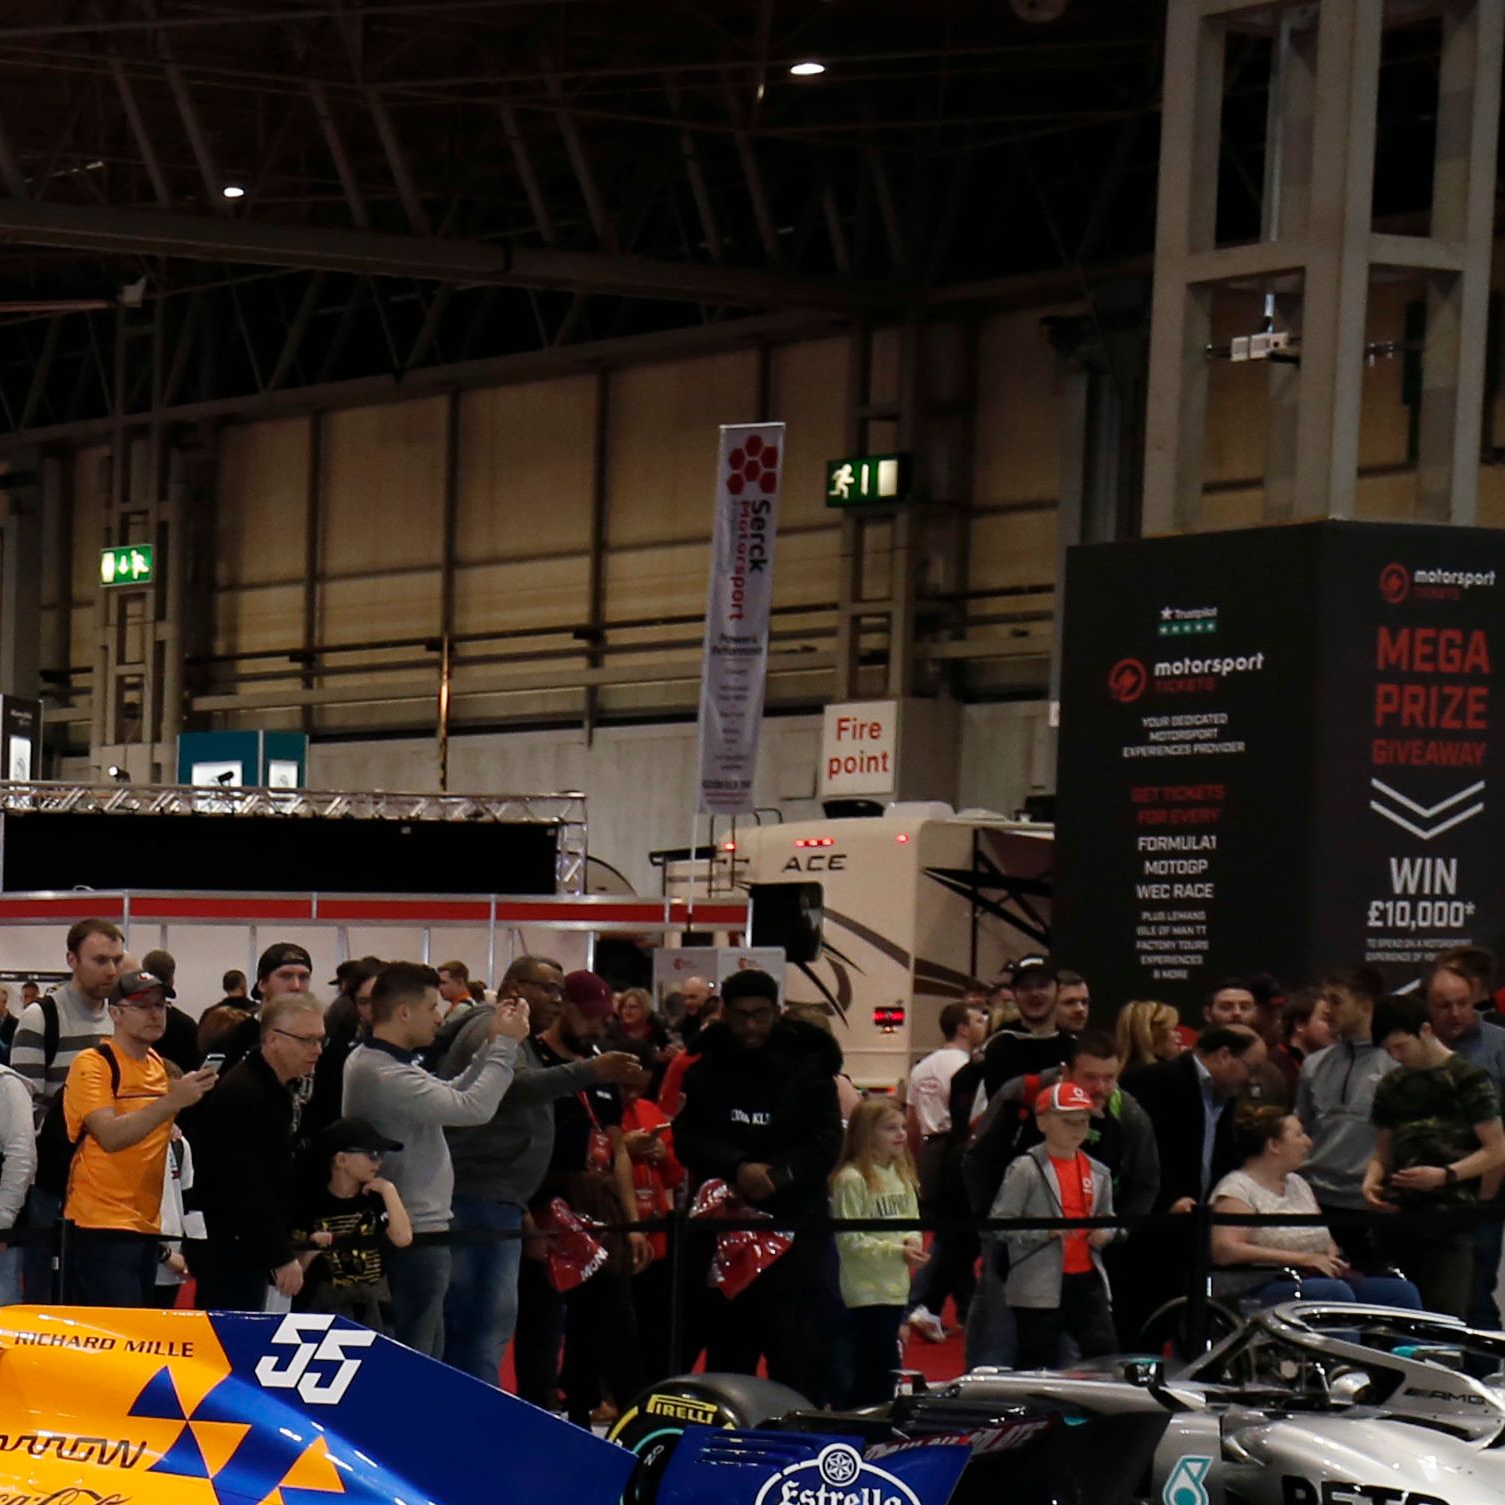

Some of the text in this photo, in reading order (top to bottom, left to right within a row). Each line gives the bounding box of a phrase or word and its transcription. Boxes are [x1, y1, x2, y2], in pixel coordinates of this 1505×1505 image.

[749, 500, 771, 573] Serck
[729, 501, 751, 620] Motorsport
[1414, 569, 1495, 588] motorsport
[1154, 652, 1265, 676] motorsport
[1377, 626, 1490, 674] MEGA
[1374, 683, 1488, 730] PRIZE
[837, 715, 882, 741] Fire
[828, 748, 890, 781] point
[1372, 738, 1488, 766] GIVEAWAY
[1138, 835, 1217, 851] FORMULA1
[1144, 859, 1209, 875] MOTOGP
[1390, 857, 1457, 895] WIN
[1136, 883, 1215, 899] WEC RACE
[14, 1330, 194, 1359] RICHARD MILLE
[254, 1312, 378, 1404] 55
[646, 1394, 719, 1425] PIRELLI
